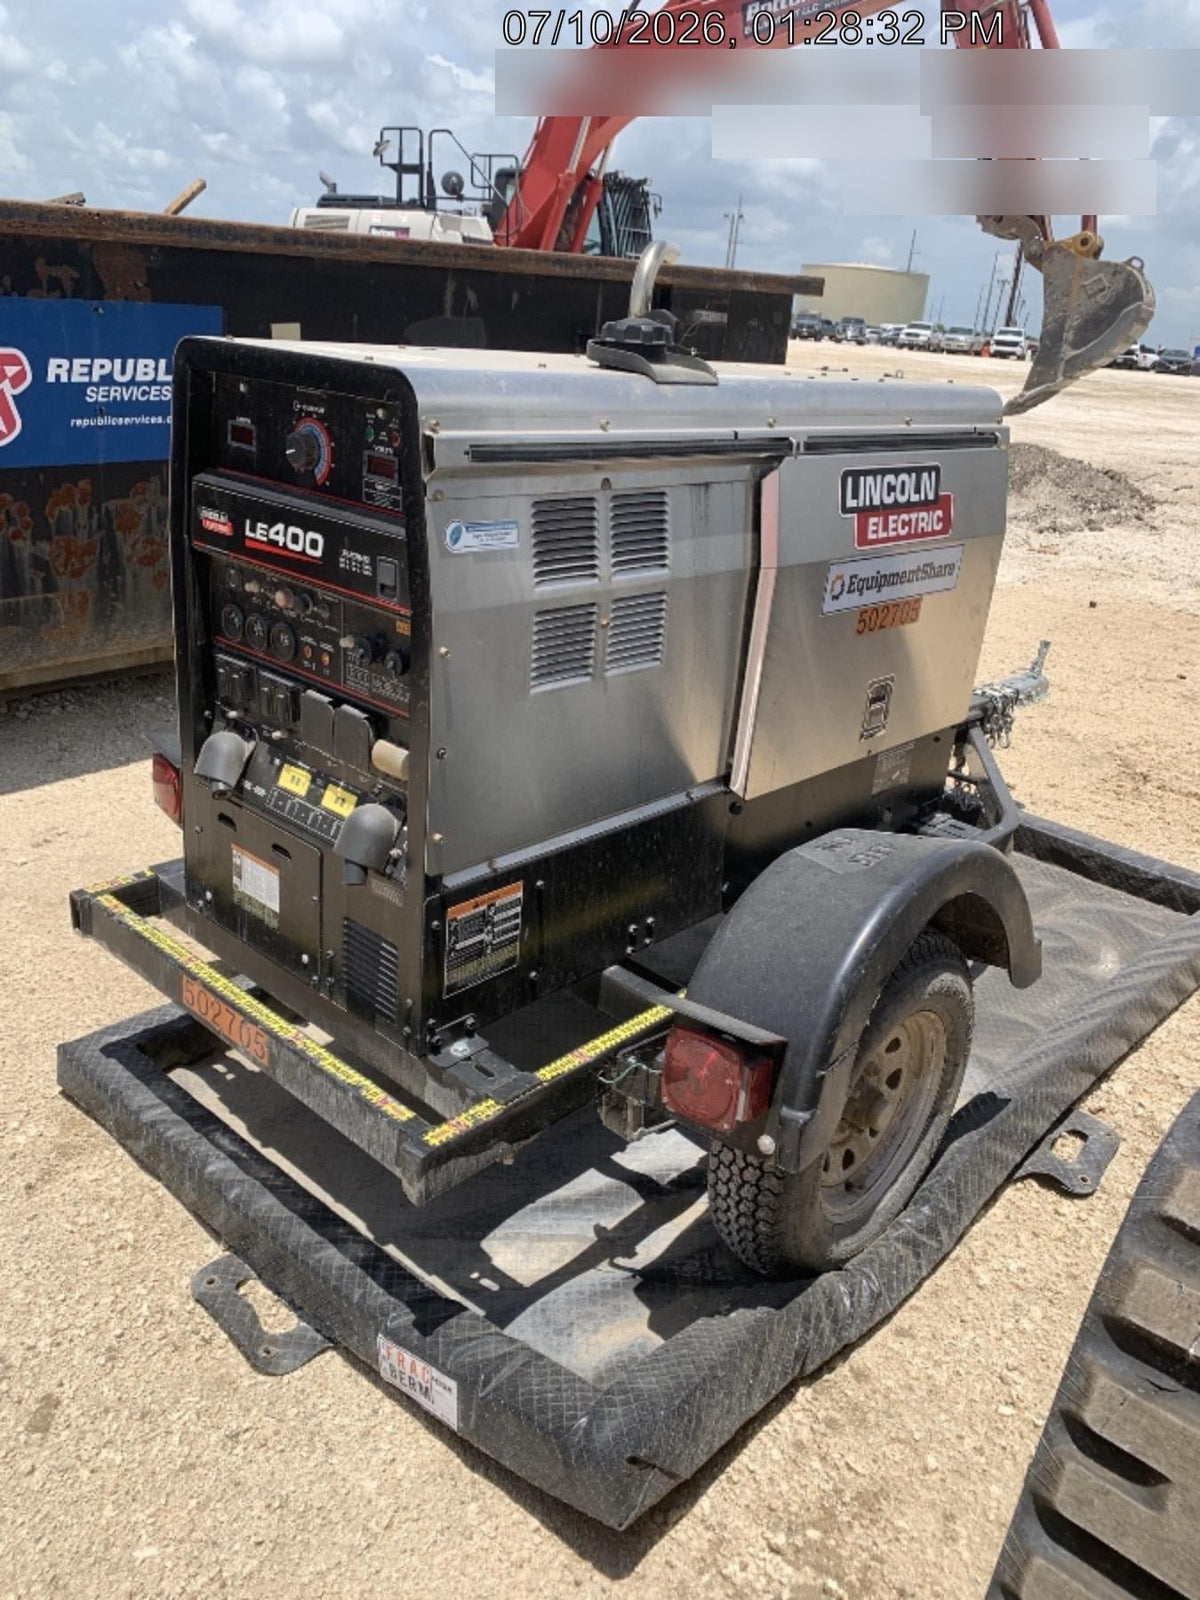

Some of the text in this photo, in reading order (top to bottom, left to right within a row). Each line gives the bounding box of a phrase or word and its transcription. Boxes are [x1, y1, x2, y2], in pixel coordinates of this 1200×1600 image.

[47, 358, 173, 382] REPUBL
[85, 385, 172, 402] SERVICES
[70, 414, 172, 428] republicservices.c
[845, 470, 936, 508] LINCOLN
[244, 518, 324, 558] LE400
[867, 509, 944, 540] ELECTRIC
[846, 561, 956, 596] EquipmentShare
[856, 600, 921, 635] 502705
[184, 978, 267, 1061] 502705
